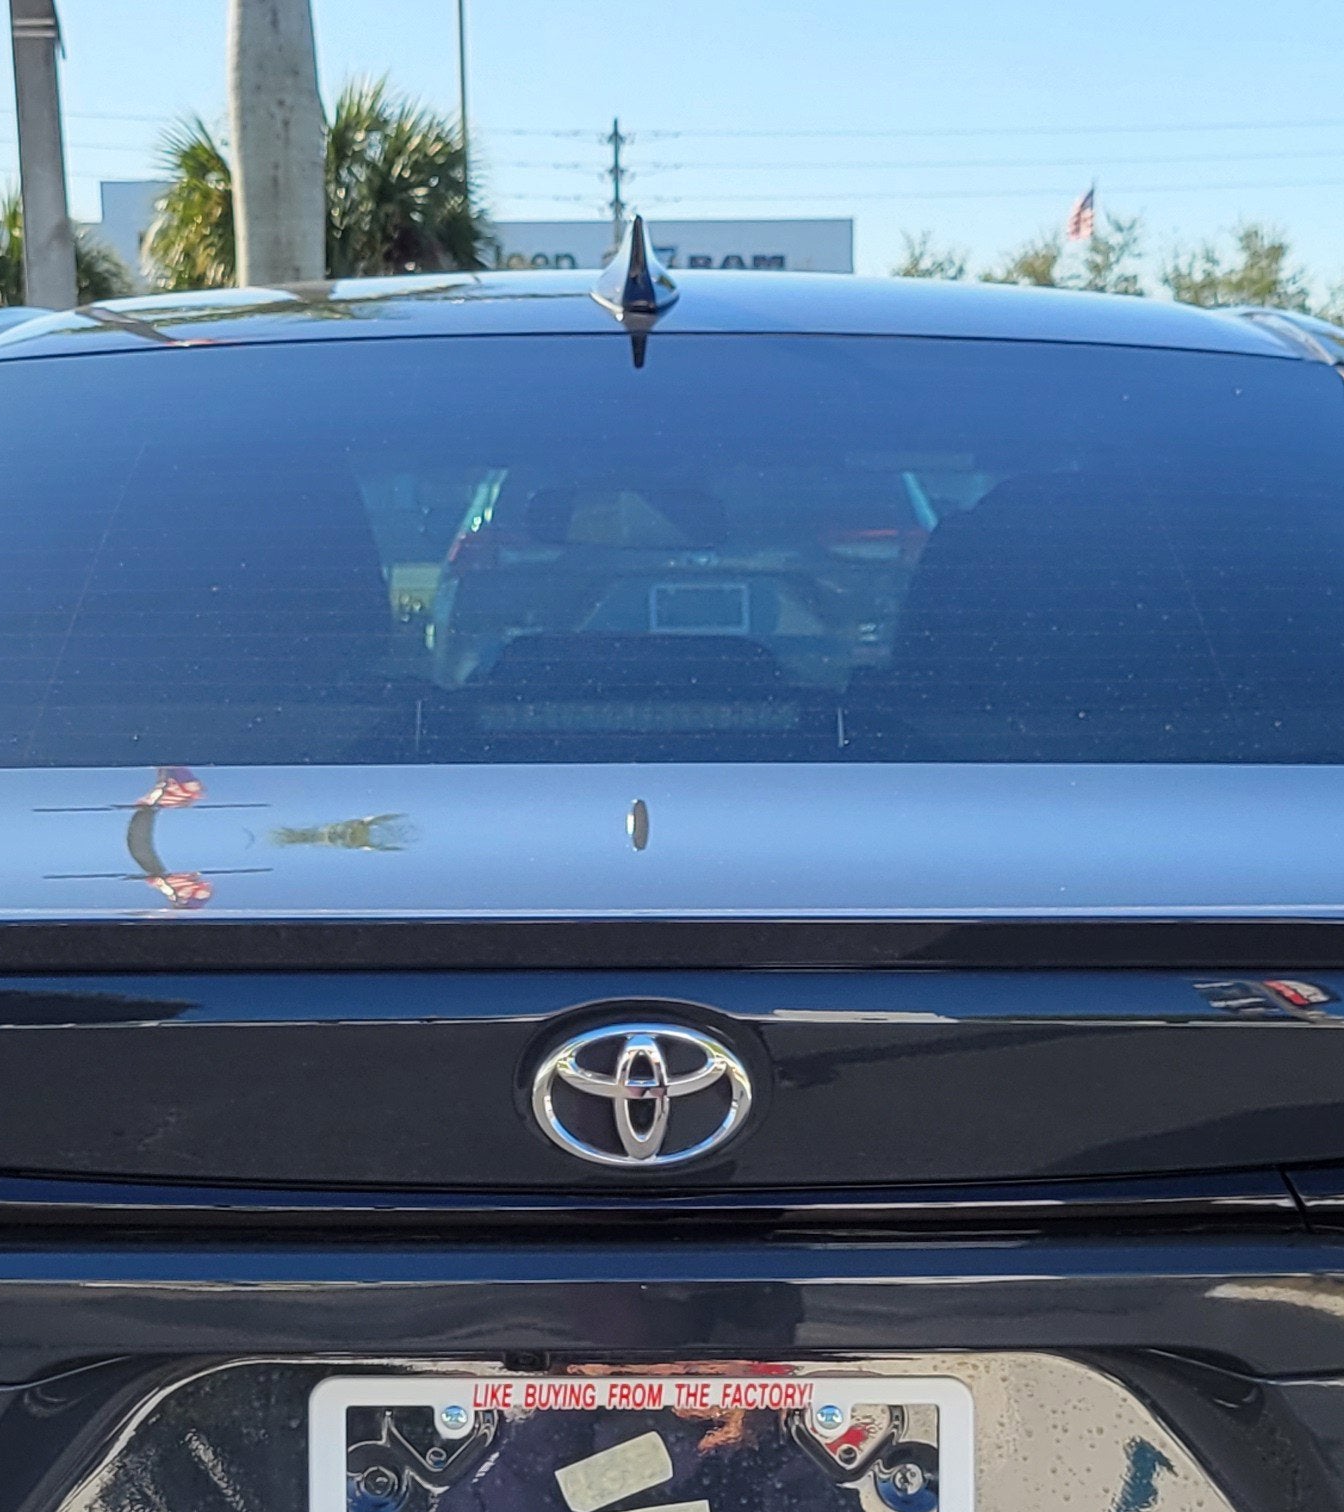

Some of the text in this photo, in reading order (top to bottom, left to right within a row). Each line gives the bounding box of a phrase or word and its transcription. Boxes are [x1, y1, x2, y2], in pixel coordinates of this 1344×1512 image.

[473, 1383, 814, 1408] LIKE BUYING FROM THE FACTORY!
